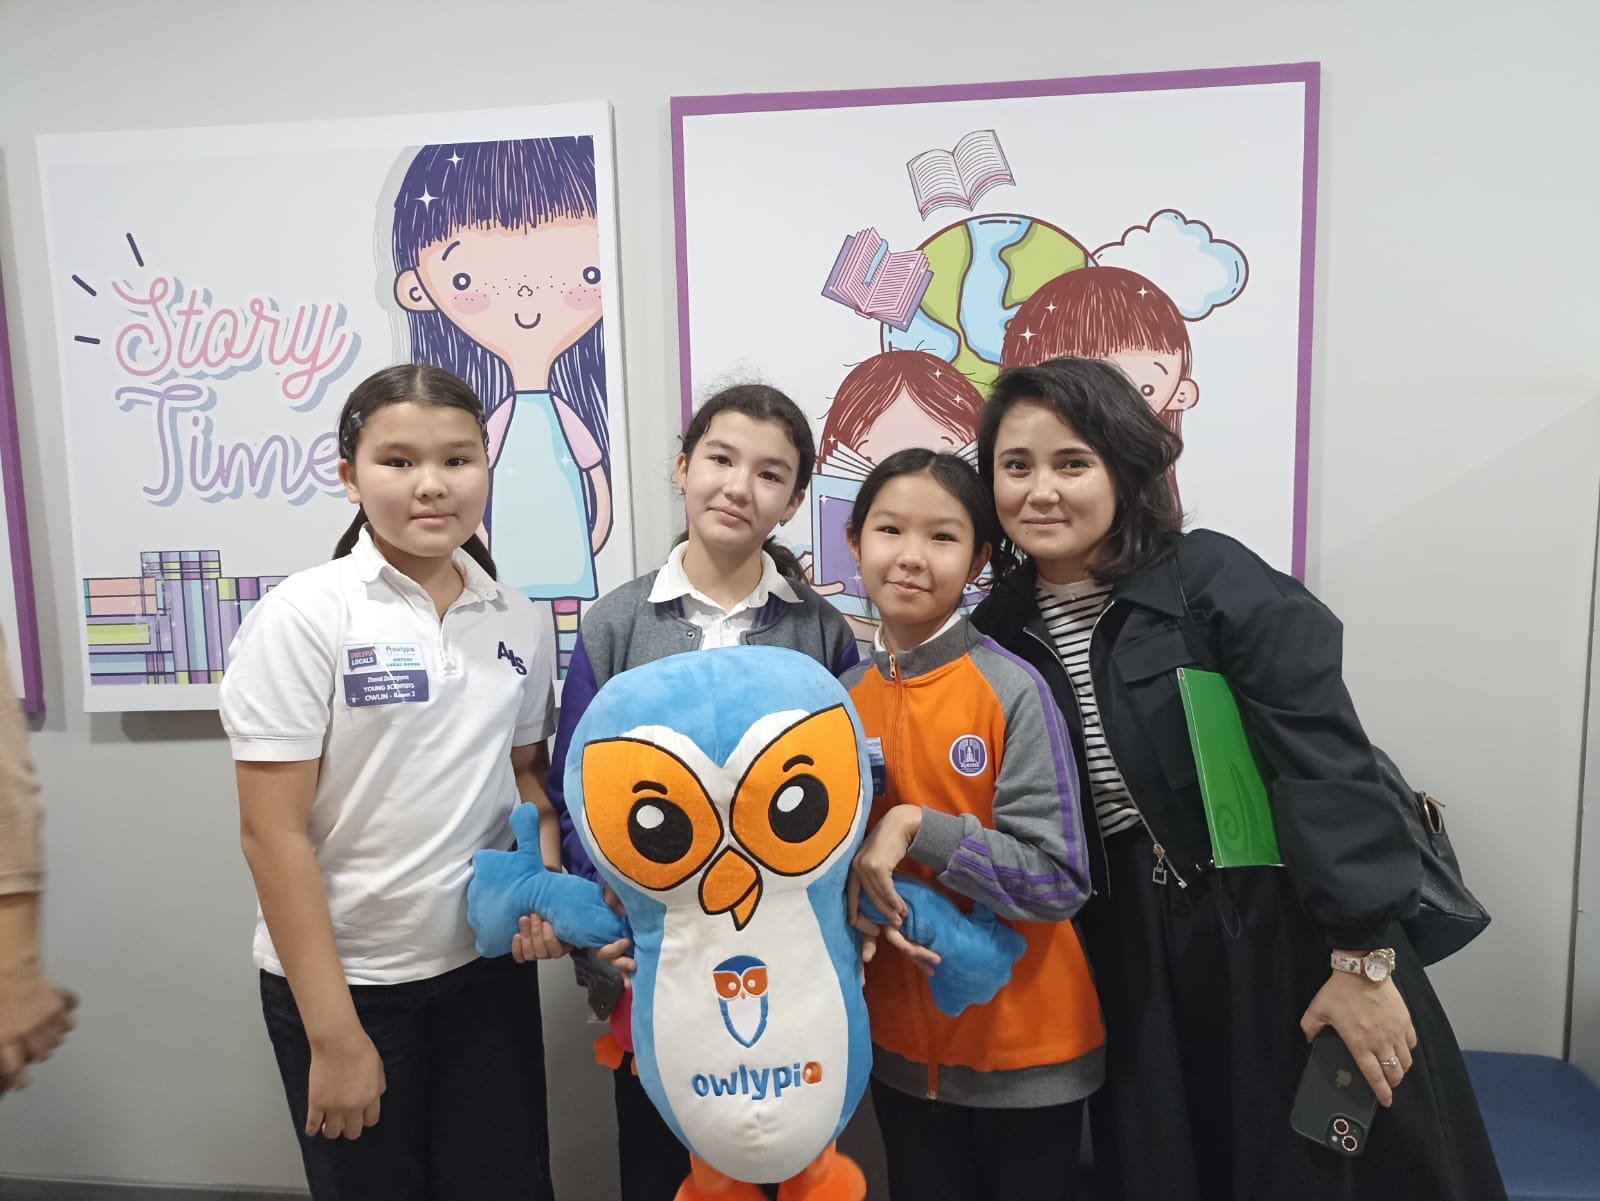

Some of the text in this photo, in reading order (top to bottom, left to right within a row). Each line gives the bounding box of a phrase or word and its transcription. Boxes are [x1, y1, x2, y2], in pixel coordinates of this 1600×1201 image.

[111, 277, 350, 403] Story
[115, 383, 345, 500] Time
[351, 657, 374, 666] LOCALS
[497, 641, 528, 676] AIS
[365, 692, 388, 701] OWLIN
[691, 1061, 823, 1100] owlypia
